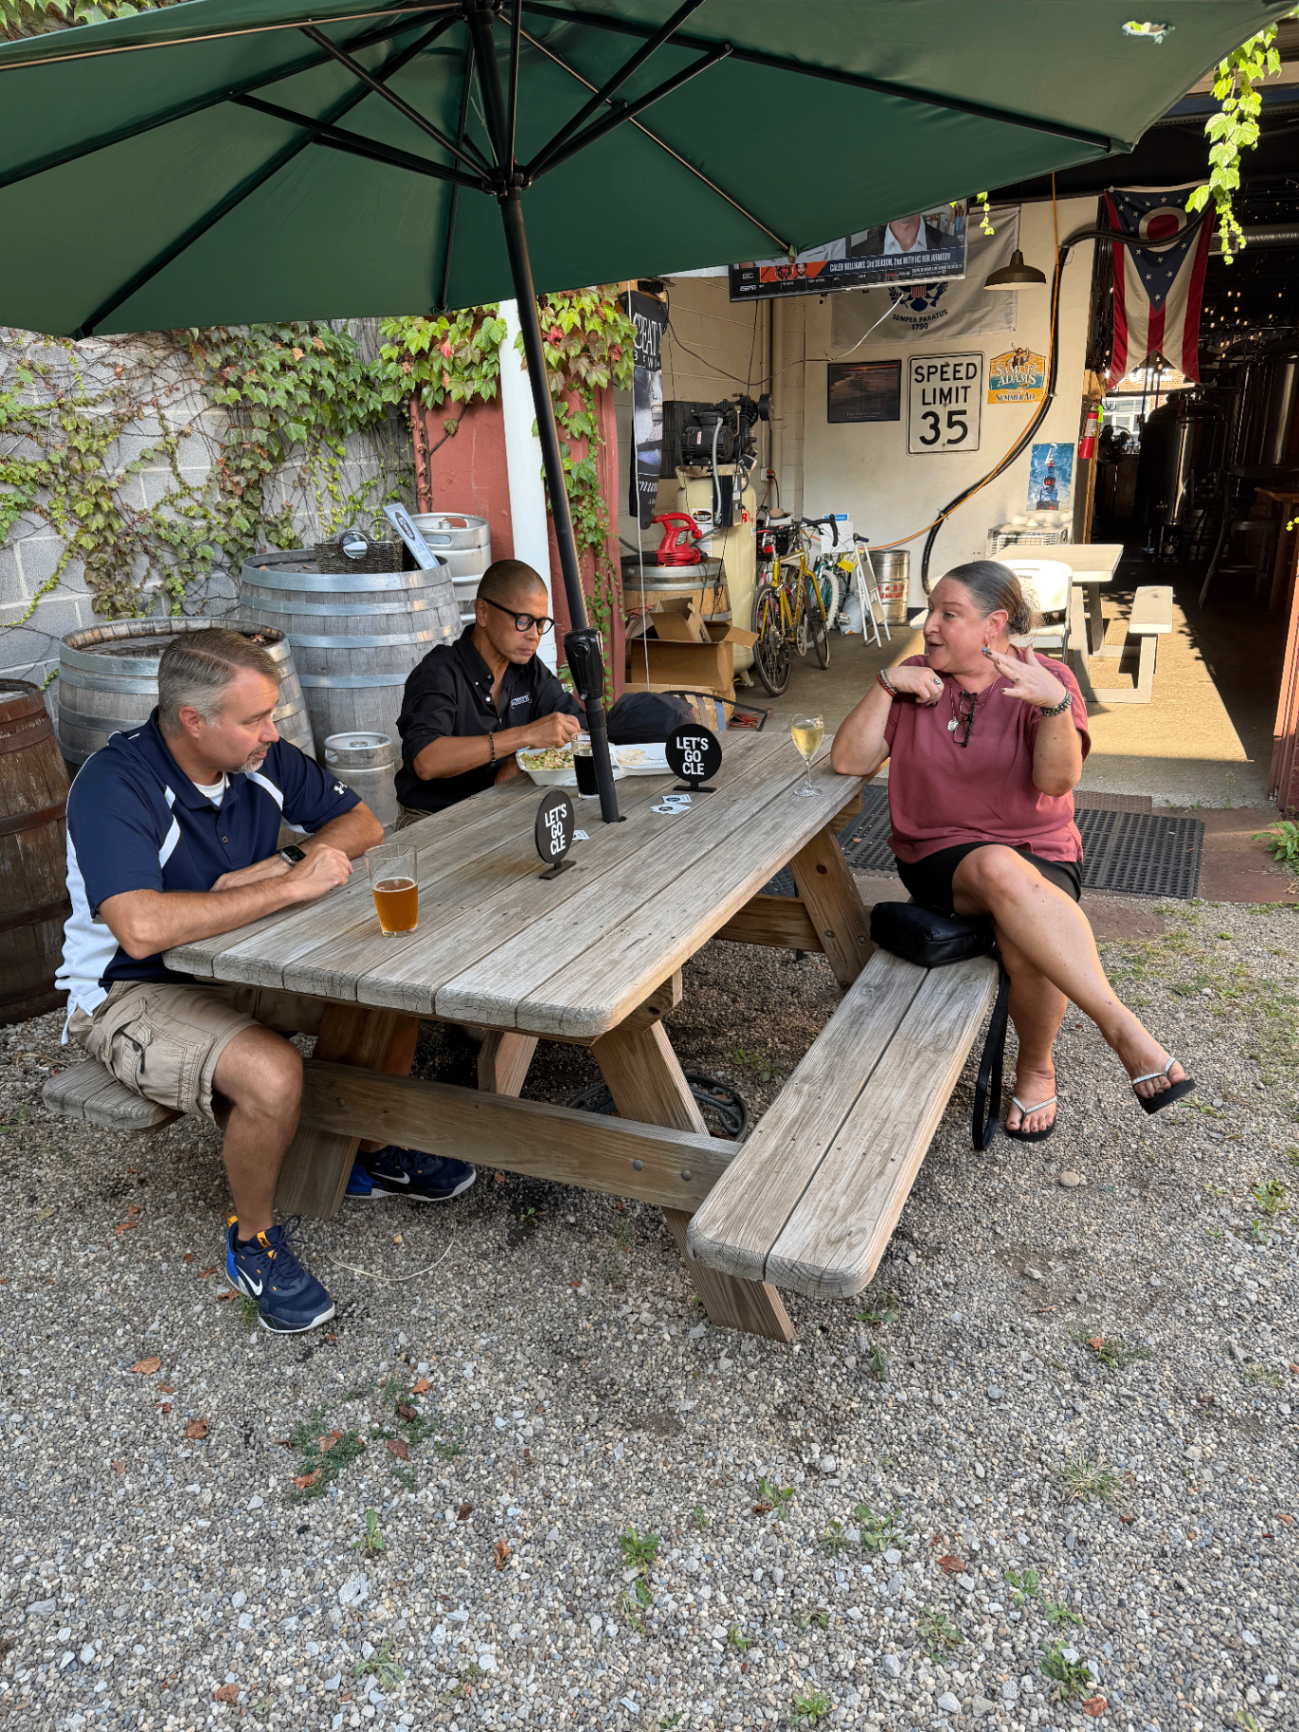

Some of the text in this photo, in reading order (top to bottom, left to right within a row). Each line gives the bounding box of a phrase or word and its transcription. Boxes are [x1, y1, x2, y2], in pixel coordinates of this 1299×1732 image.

[829, 263, 843, 272] CALEB
[892, 309, 948, 323] SEMPER PARATUS
[911, 323, 928, 331] 1790
[914, 362, 977, 383] SPEED
[995, 363, 1037, 377] SAMUEL
[997, 374, 1036, 387] ADAMS
[922, 386, 971, 406] LIMIT
[995, 393, 1023, 401] SUMMER
[919, 409, 968, 446] 35
[676, 736, 709, 751] LET'S
[684, 749, 702, 763] GO
[682, 762, 705, 775] CLE
[544, 803, 568, 828] LET'S
[551, 821, 563, 839] GO
[550, 834, 567, 856] CLE
